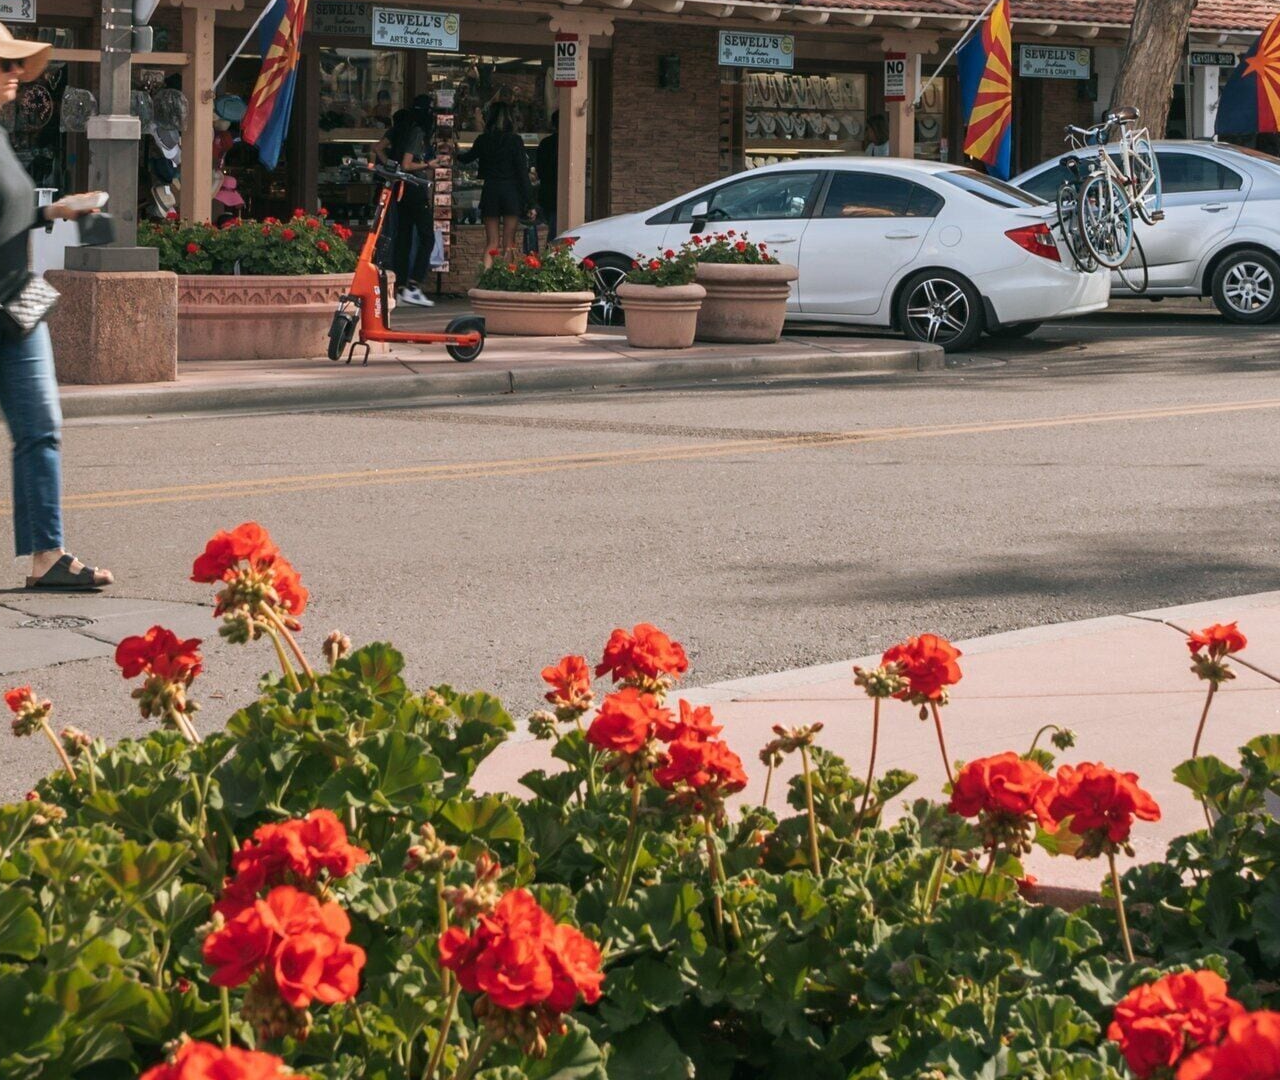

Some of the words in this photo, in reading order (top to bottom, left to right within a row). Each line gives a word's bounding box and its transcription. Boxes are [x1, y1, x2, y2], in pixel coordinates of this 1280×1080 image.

[378, 12, 442, 29] SEWELL'S
[389, 34, 409, 45] ARTS
[416, 37, 443, 47] CRAFTS
[724, 35, 779, 49] SEWELL'S
[557, 42, 577, 57] NO
[1025, 49, 1075, 61] SEWELL'S
[886, 61, 904, 74] NO
